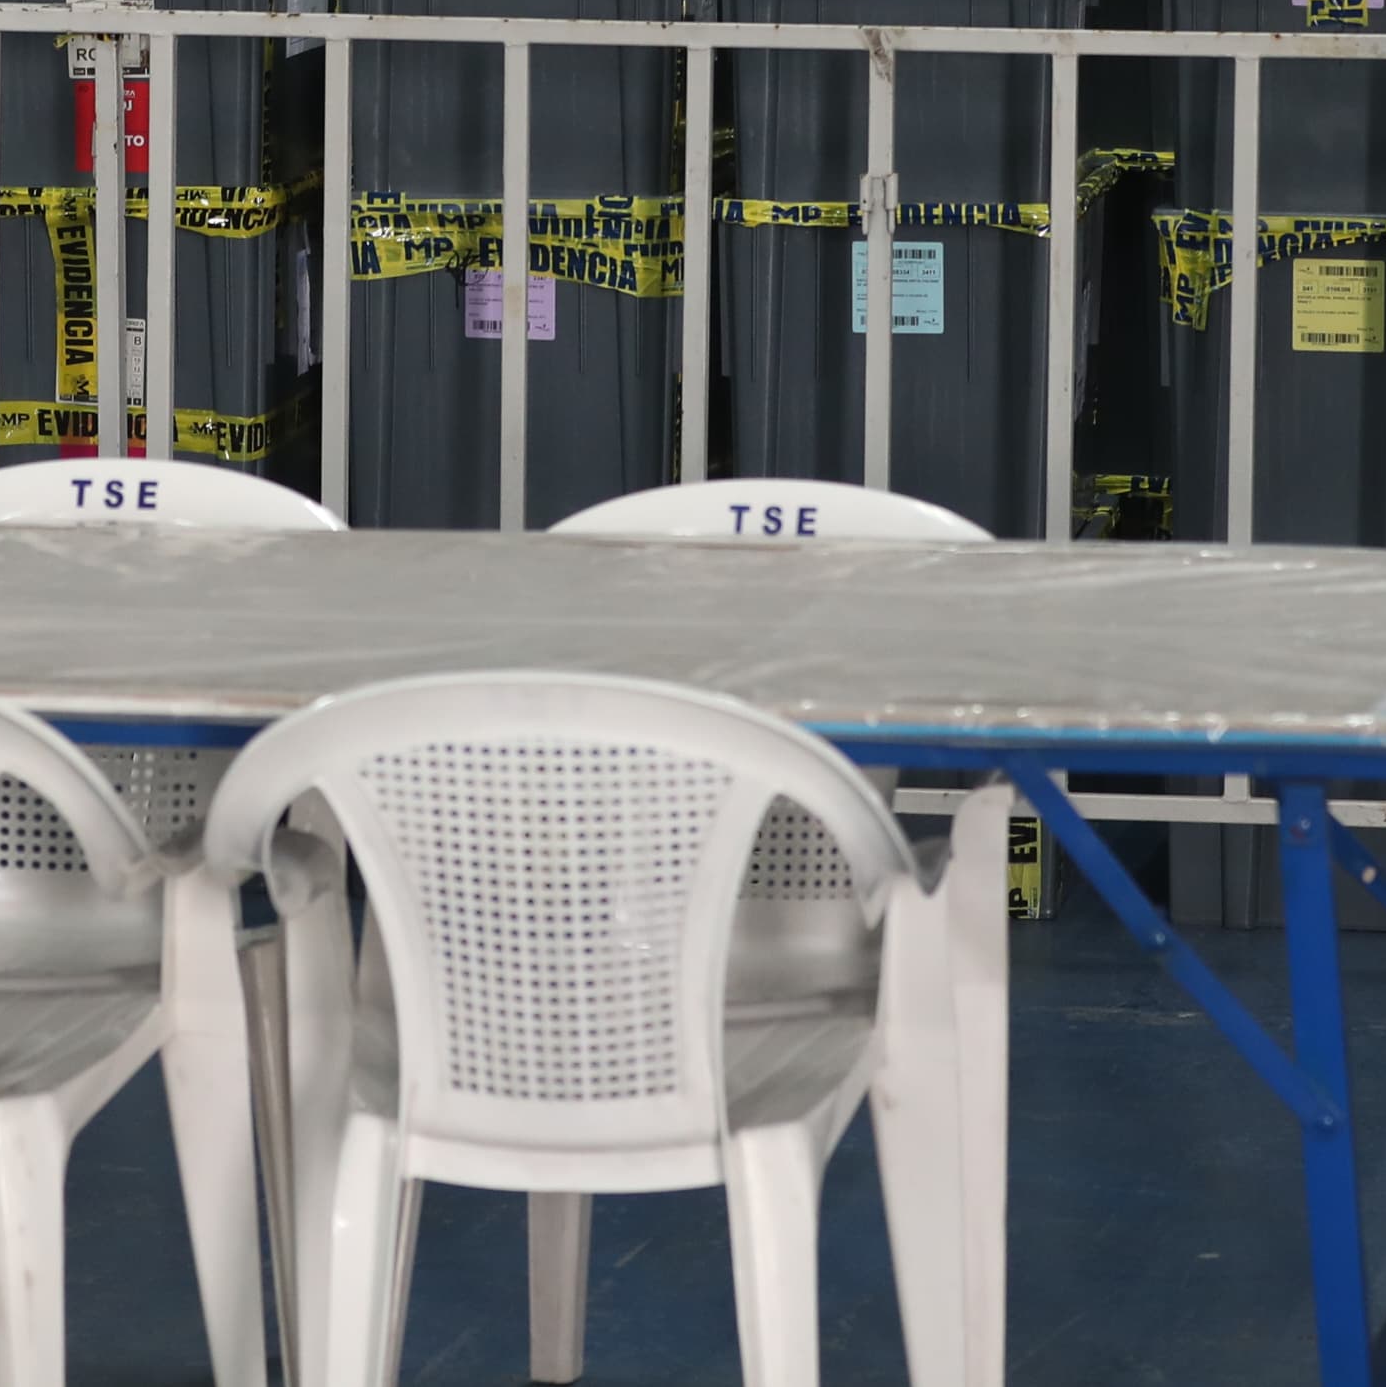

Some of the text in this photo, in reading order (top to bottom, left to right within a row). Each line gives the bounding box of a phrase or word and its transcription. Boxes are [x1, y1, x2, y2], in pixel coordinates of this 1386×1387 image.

[772, 205, 821, 223] MP
[404, 237, 454, 261] MP
[479, 236, 638, 292] EDENCIA
[57, 225, 94, 366] EVIDENCIA
[1175, 272, 1197, 322] MP
[2, 412, 30, 427] MP
[72, 480, 159, 509] TSE
[729, 504, 819, 538] TSE
